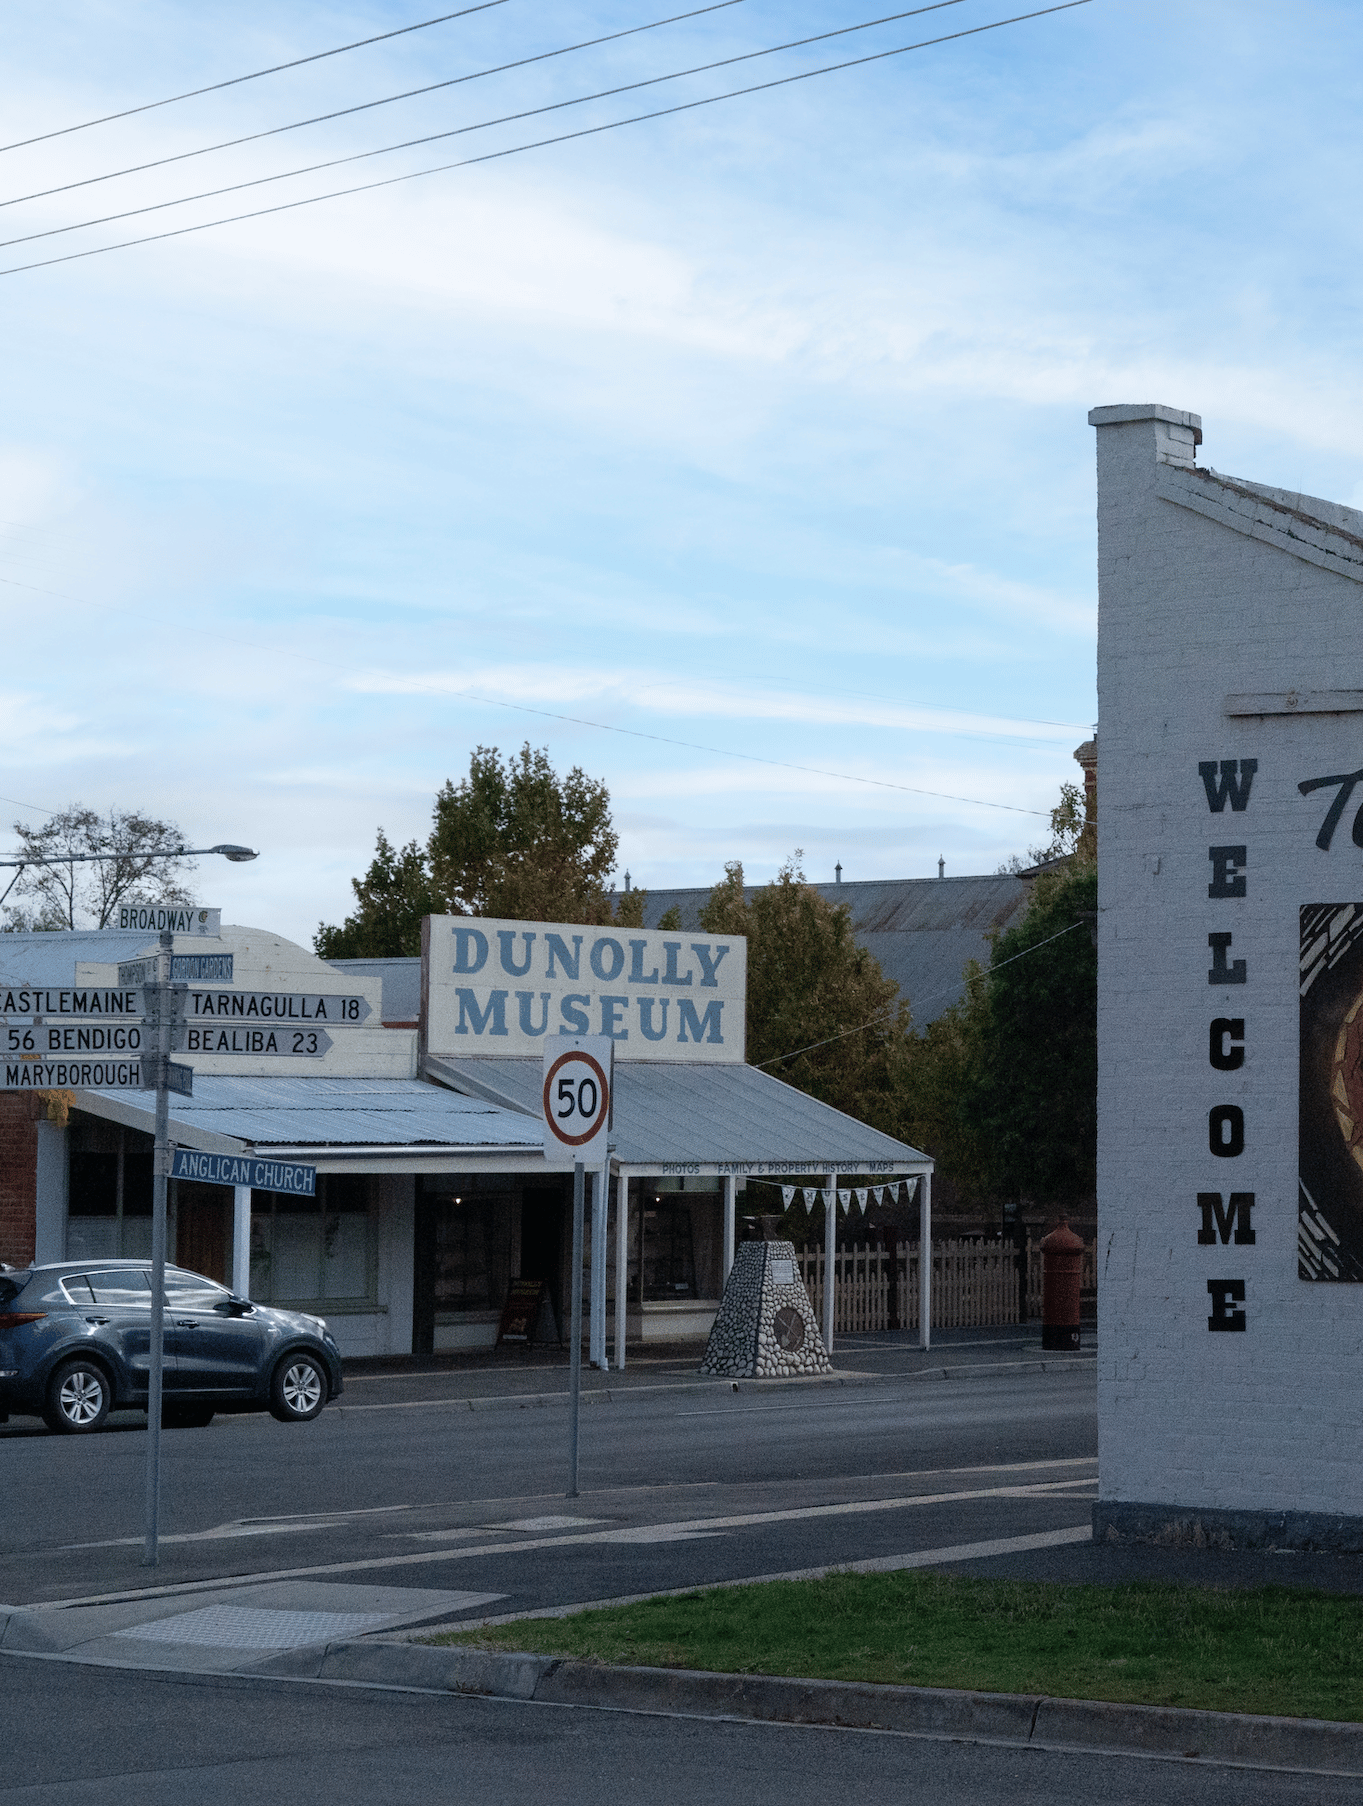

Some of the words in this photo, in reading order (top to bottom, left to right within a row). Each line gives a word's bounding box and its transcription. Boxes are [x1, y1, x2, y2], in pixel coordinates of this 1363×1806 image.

[120, 908, 194, 932] BROADWAY
[451, 927, 730, 987] DUNOLLY
[0, 991, 137, 1013] ASTLEMAINE
[192, 993, 328, 1019] TARNAGULLA
[341, 999, 360, 1020] 18
[454, 988, 725, 1044] MUSEUM
[8, 1029, 35, 1050] 56
[48, 1028, 141, 1050] BENDIGO
[187, 1030, 278, 1052] BEALIBA
[292, 1033, 318, 1053] 23
[1197, 758, 1258, 1332] WELCOME
[6, 1064, 140, 1085] MARYBOROUGH
[557, 1078, 597, 1118] 50
[179, 1154, 250, 1182] ANGLICAN
[254, 1160, 314, 1191] CHURCH
[662, 1164, 700, 1174] PHOTOS
[717, 1163, 754, 1174] FAMILY
[758, 1164, 765, 1173] &
[768, 1163, 819, 1174] PROPERTY
[822, 1163, 860, 1173] HISTORY
[869, 1162, 894, 1172] MAPS
